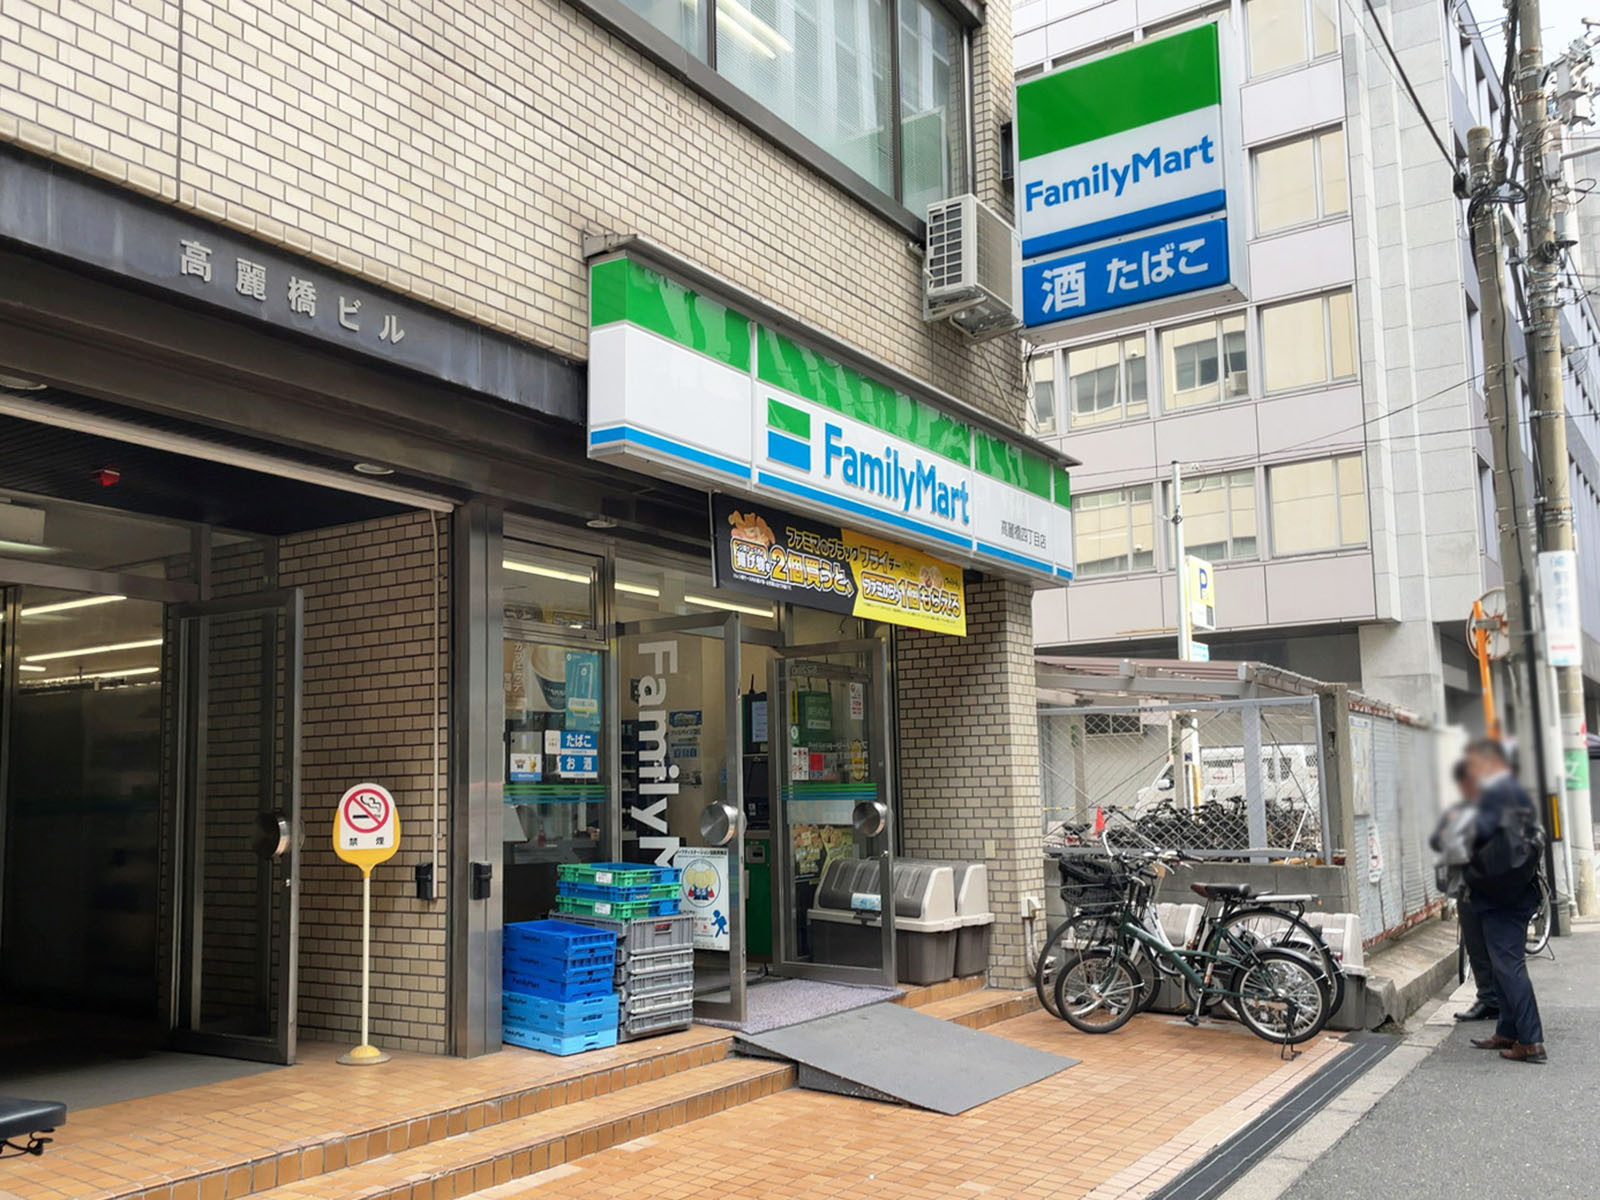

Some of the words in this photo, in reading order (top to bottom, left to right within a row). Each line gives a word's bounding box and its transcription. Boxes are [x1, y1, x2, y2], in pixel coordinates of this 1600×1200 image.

[1025, 135, 1215, 212] FamilyMart
[180, 239, 405, 345] 高麗橋ビル
[1041, 261, 1086, 313] 酒
[1106, 238, 1208, 294] たばこ
[824, 422, 970, 525] FamilyMart
[1199, 568, 1208, 600] P
[566, 733, 592, 748] たばこ
